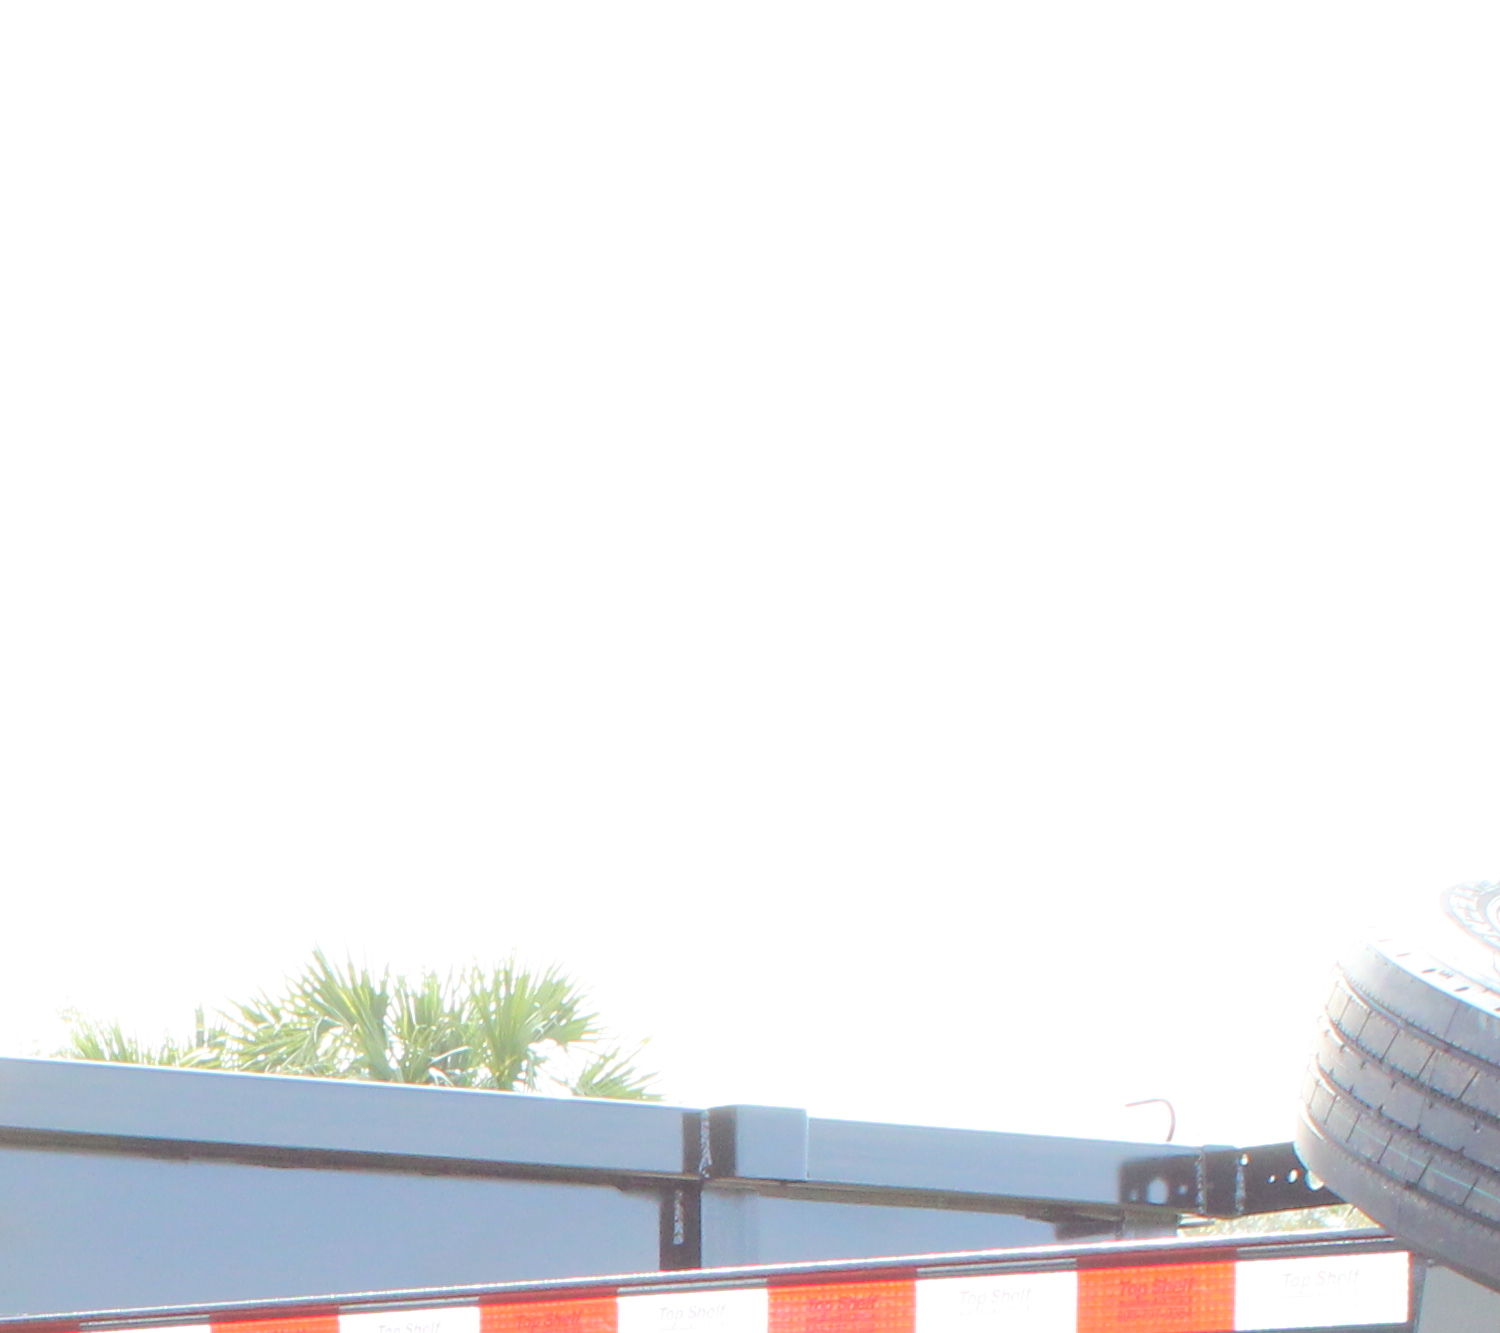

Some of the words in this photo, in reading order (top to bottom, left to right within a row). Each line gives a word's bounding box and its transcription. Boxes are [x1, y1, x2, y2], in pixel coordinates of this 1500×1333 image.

[1282, 1272, 1311, 1294] Top
[1316, 1268, 1360, 1287] Shelf
[959, 1290, 987, 1311] Top
[990, 1287, 1032, 1305] Shelf
[658, 1306, 684, 1328] Top
[687, 1303, 726, 1320] Shelf
